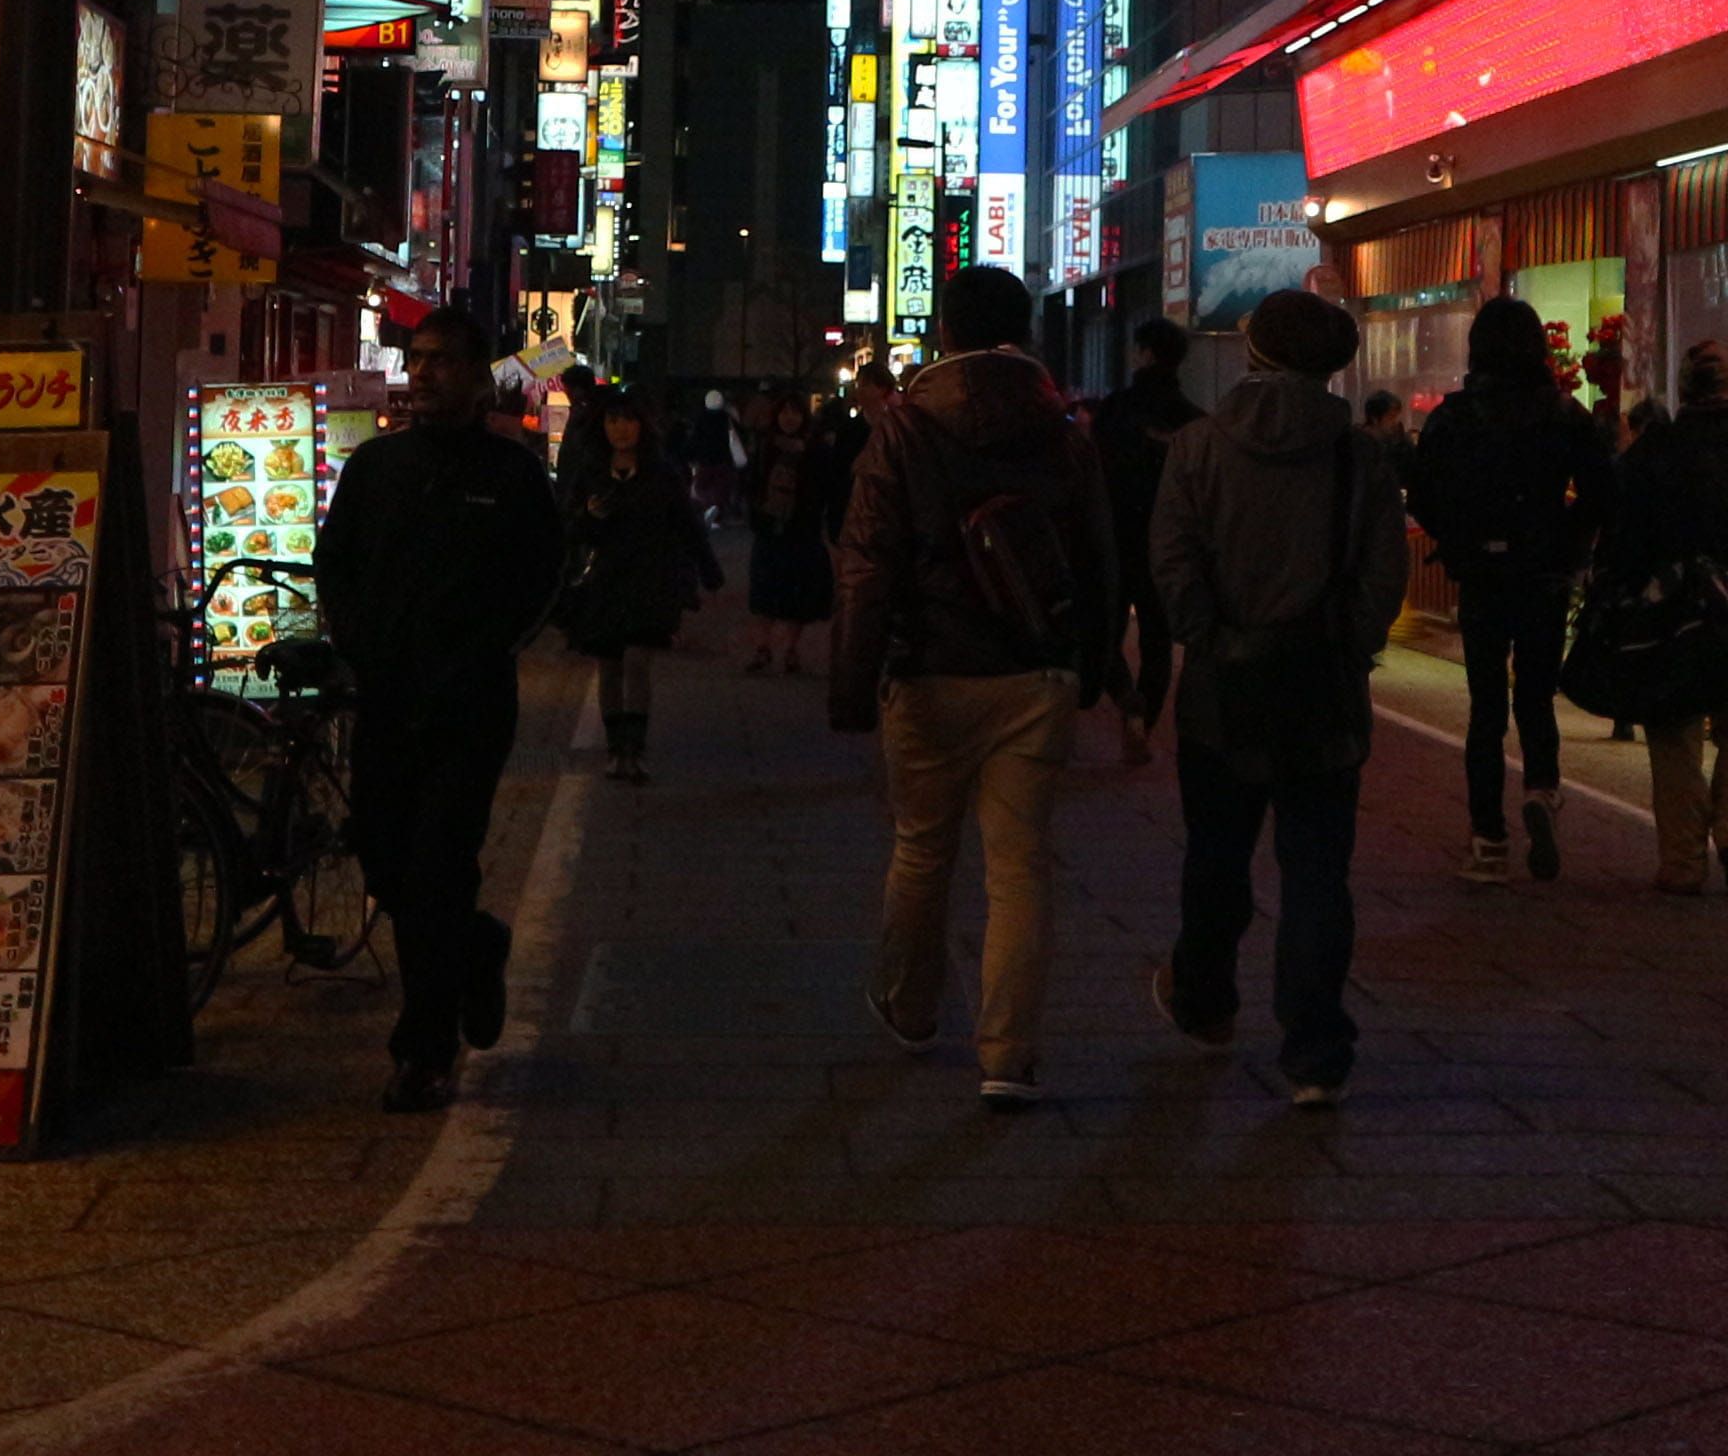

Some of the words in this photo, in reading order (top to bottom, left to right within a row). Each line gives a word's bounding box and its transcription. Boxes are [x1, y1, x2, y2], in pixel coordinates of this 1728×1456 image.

[204, 1, 292, 93] 薬
[378, 22, 409, 45] B1
[990, 26, 1018, 89] Your
[989, 90, 1018, 135] For
[988, 195, 1006, 256] LABI
[220, 408, 296, 433] 夜来香
